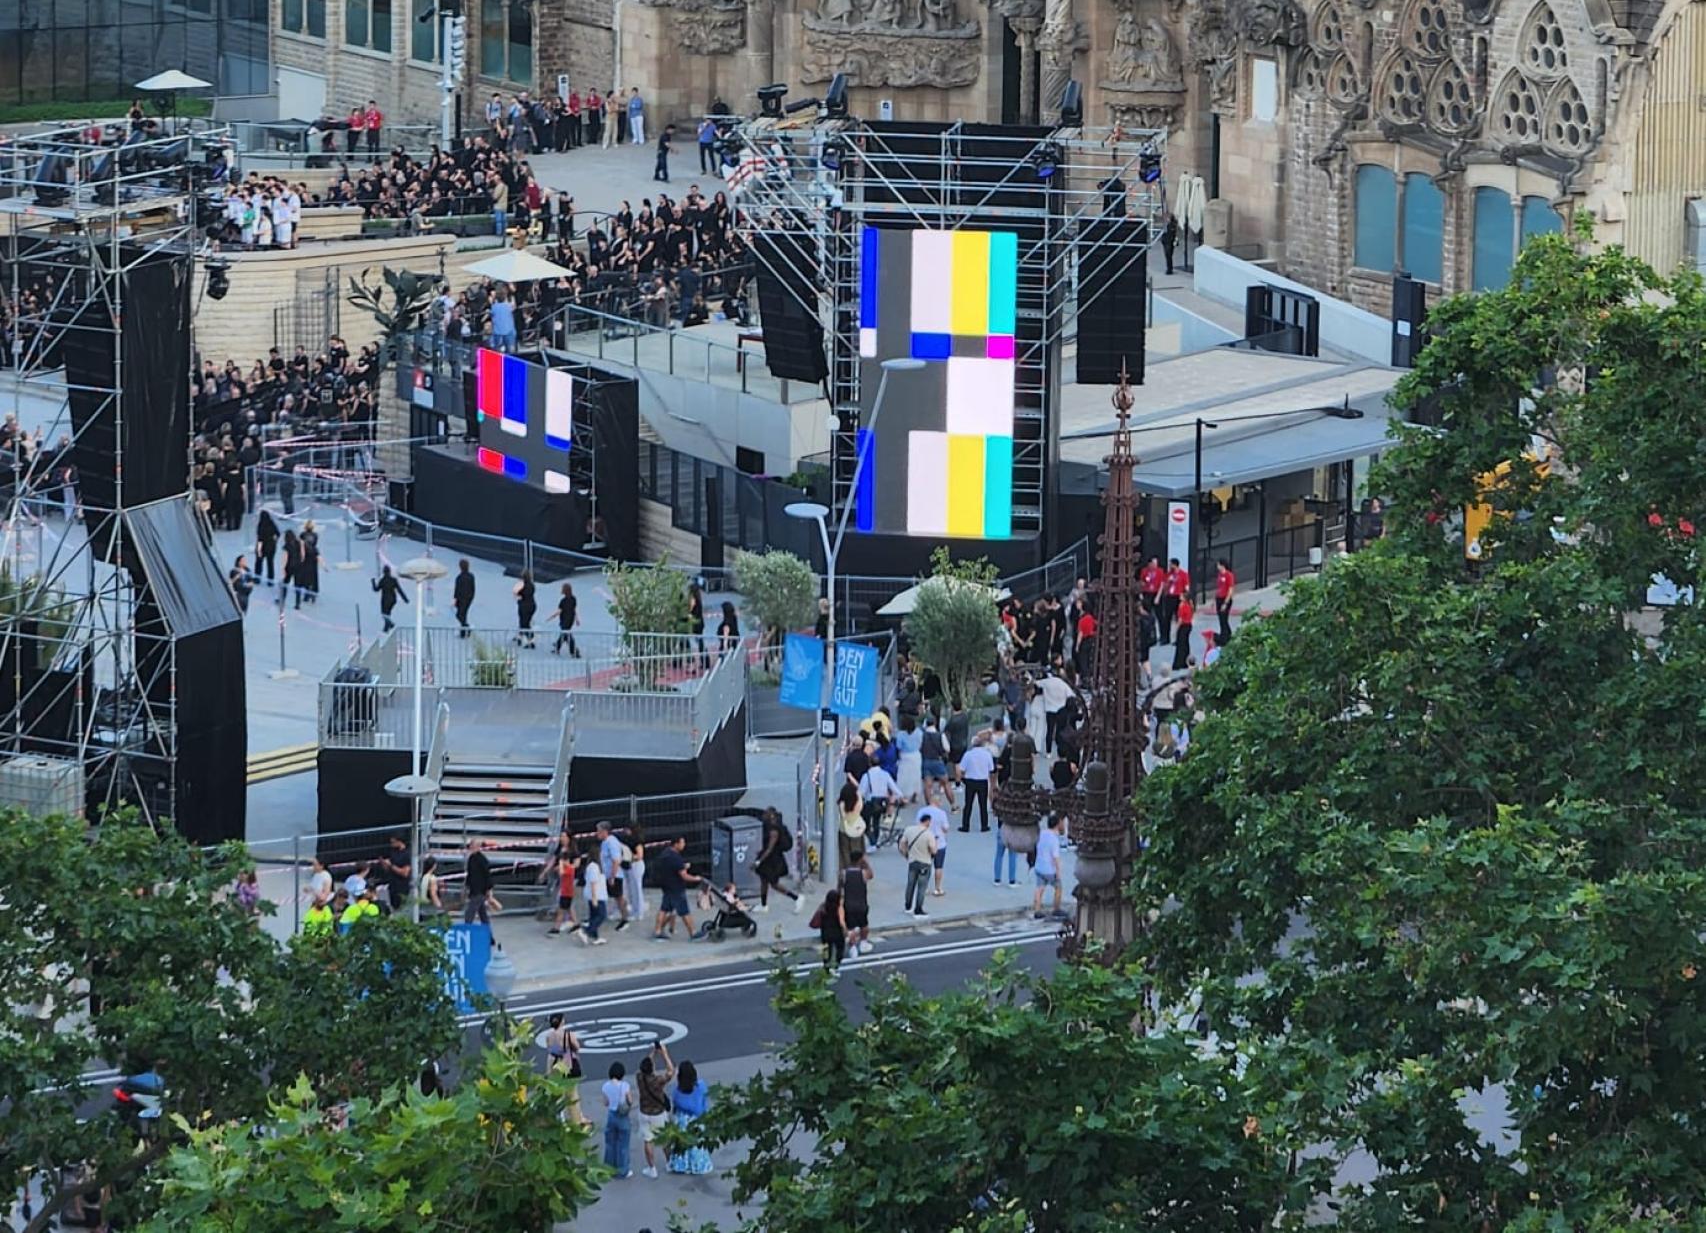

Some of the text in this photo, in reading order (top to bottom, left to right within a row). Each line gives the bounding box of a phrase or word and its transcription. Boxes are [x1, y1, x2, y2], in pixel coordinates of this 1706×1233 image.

[837, 646, 865, 670] BEN
[836, 666, 858, 688] VIN
[834, 685, 858, 708] GUT
